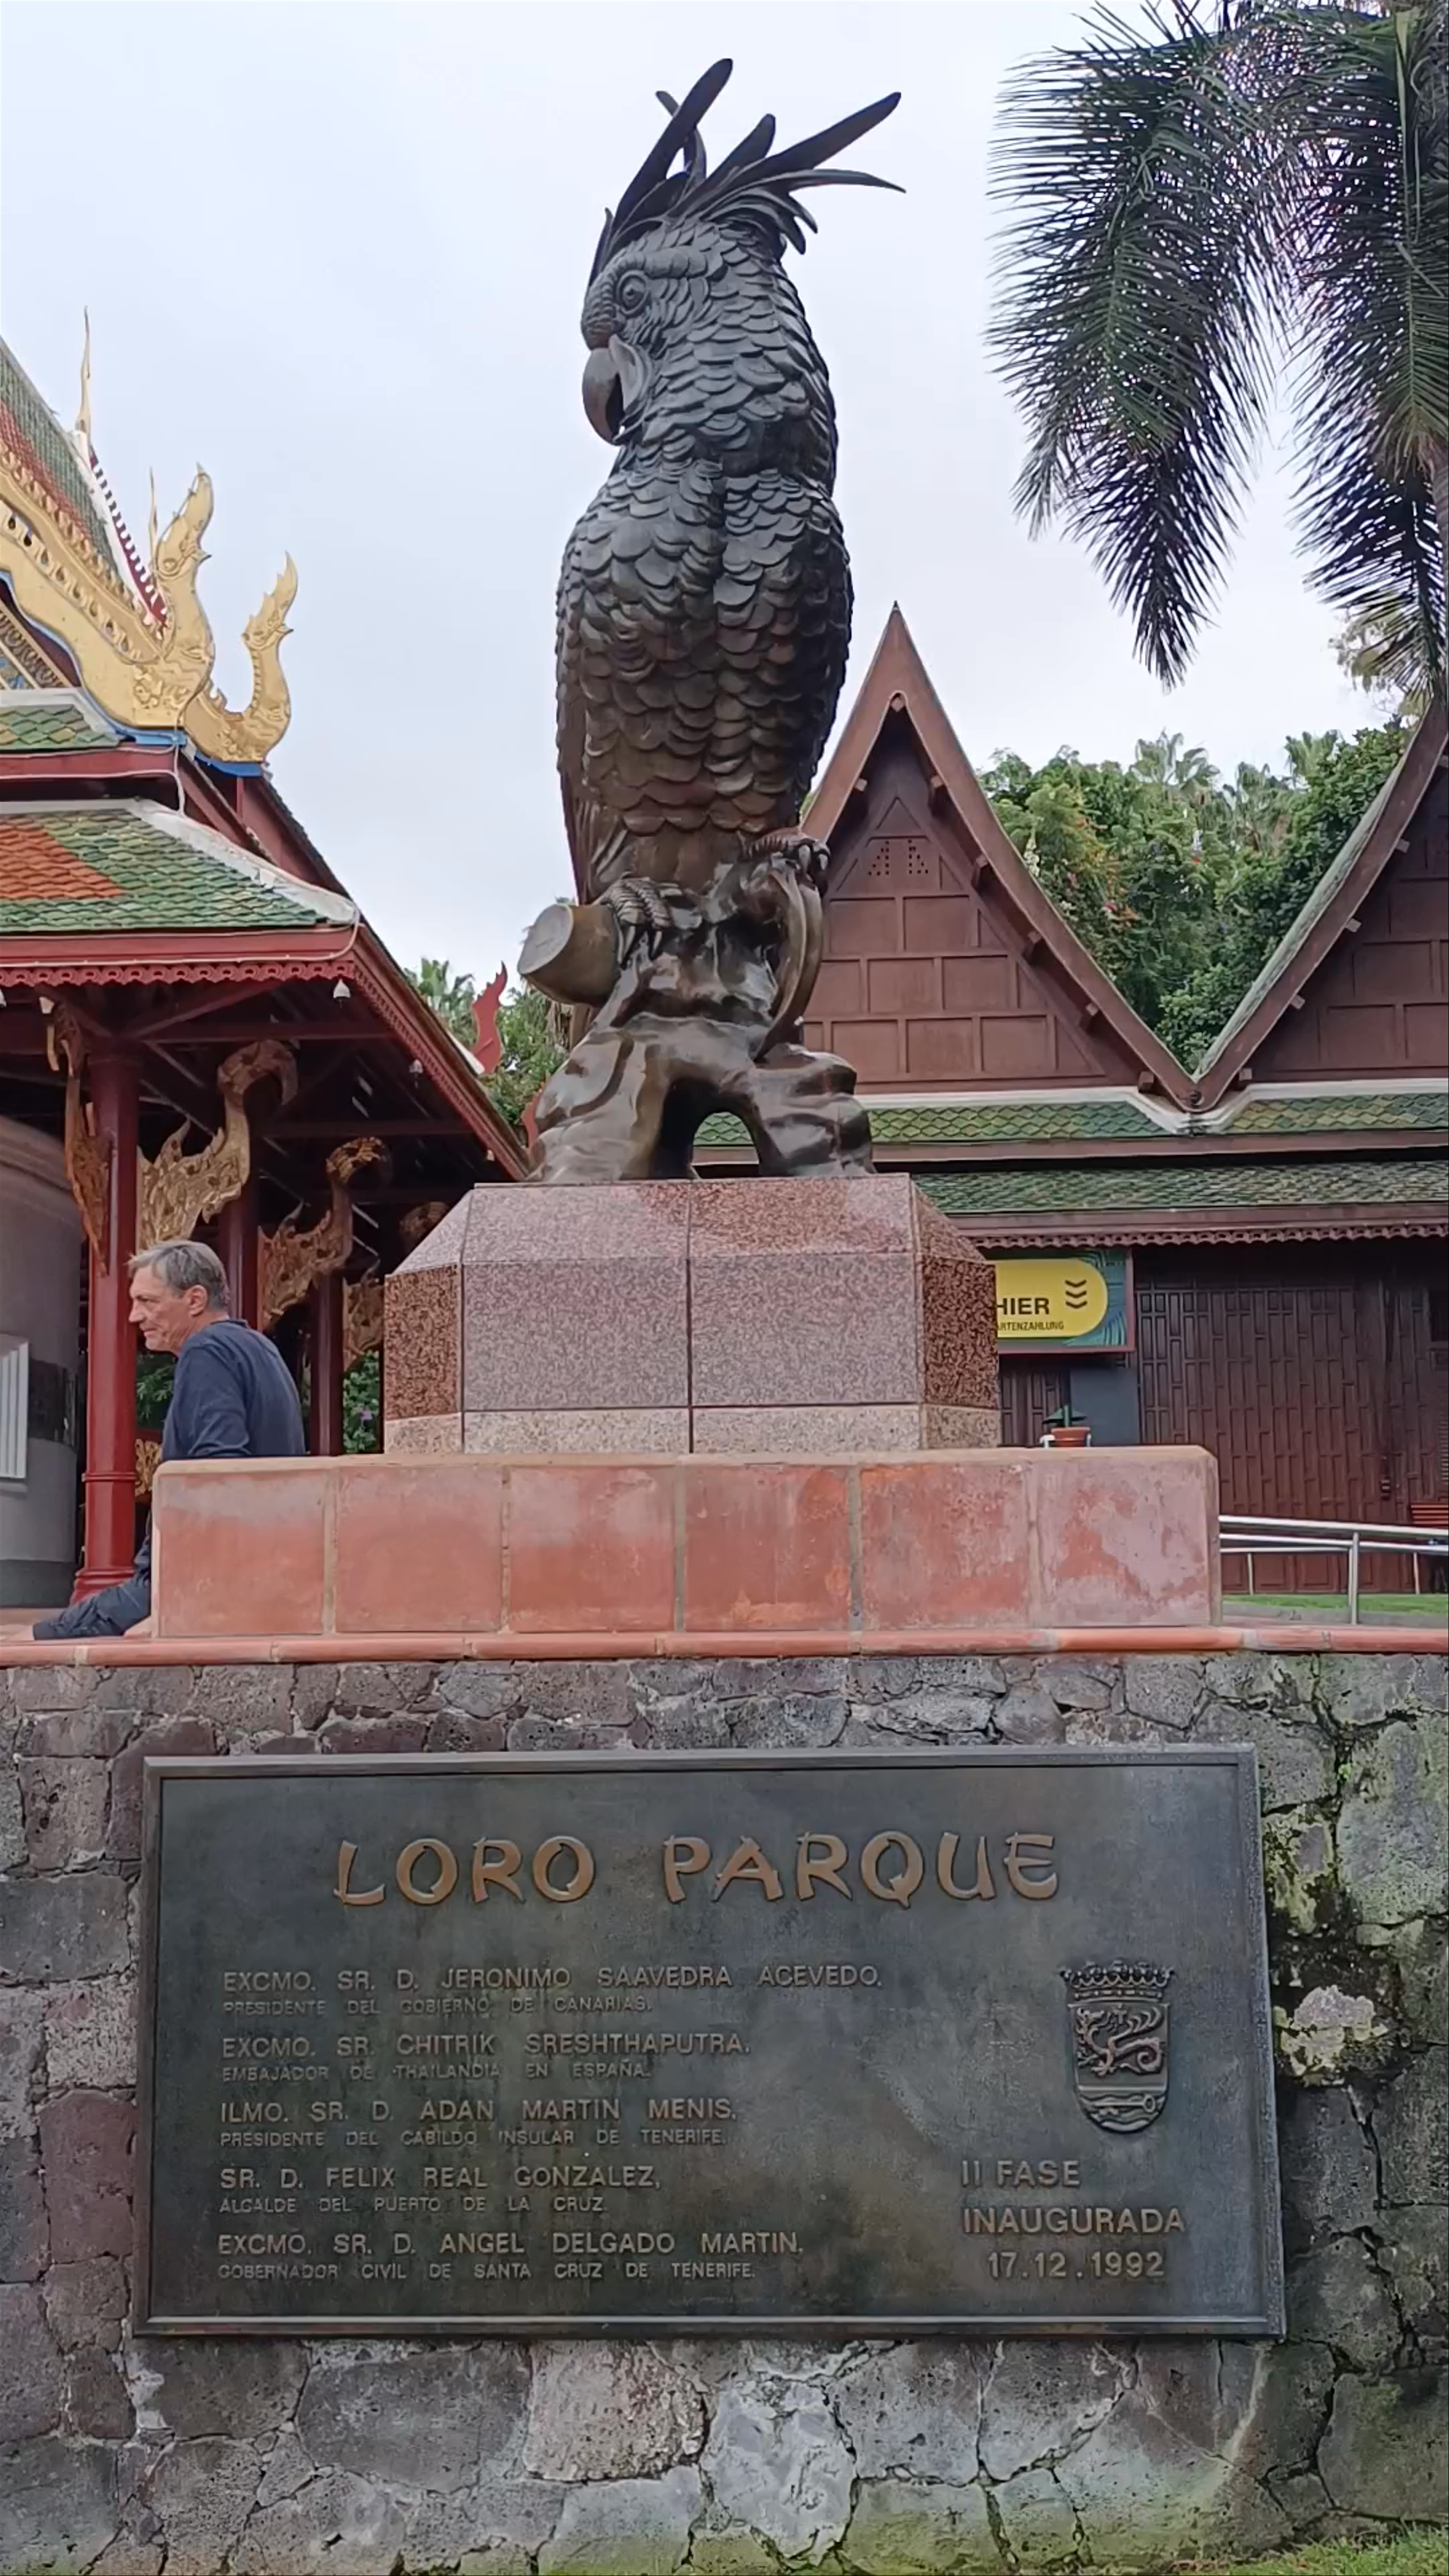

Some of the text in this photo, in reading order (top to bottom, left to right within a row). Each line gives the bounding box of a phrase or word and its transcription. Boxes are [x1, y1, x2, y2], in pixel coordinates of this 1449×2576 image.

[996, 1298, 1049, 1315] HIER
[333, 1830, 1057, 1909] LORO PARQUE
[223, 1966, 882, 1992] EXCMO. SR. D. JERONIMO SAAVEDRA ACEVEDO.
[223, 1996, 652, 2015] PRESIDENTE DEL GOBIERNO DE CANARIAS.
[222, 2032, 750, 2059] EXCMO. SR. CHITRIK SRESHTHAPUTRA.
[222, 2067, 328, 2082] EMBAJADOR
[351, 2066, 373, 2080] DE
[395, 2064, 500, 2080] THAILANDIA
[526, 2064, 548, 2077] EN
[221, 2098, 736, 2123] ILMO. SR. D. ADAN MARTIN MENIS.
[220, 2132, 325, 2147] PRESIDENTE
[346, 2132, 379, 2146] DEL
[401, 2130, 477, 2145] CABILDO
[499, 2130, 574, 2144] INSULAR
[597, 2130, 620, 2144] DE
[220, 2169, 260, 2188] SR.
[281, 2169, 302, 2188] D.
[326, 2168, 396, 2187] FELIX
[423, 2167, 488, 2187] REAL
[962, 2161, 1081, 2186] II FASE
[219, 2198, 296, 2213] ALCALDE
[319, 2198, 351, 2212] DEL
[374, 2197, 441, 2212] PUERTO
[463, 2197, 486, 2211] DE
[509, 2197, 530, 2211] LA
[963, 2208, 1185, 2234] INAUGURADA
[217, 2232, 803, 2255] EXCMO. SR. D. ANGEL DELGADO MARTIN.
[218, 2264, 338, 2279] GOBERNADOR
[361, 2264, 407, 2279] CIVIL
[429, 2264, 451, 2278] DE
[474, 2264, 531, 2278] SANTA
[555, 2264, 602, 2278] CRUZ
[626, 2264, 648, 2278] DE
